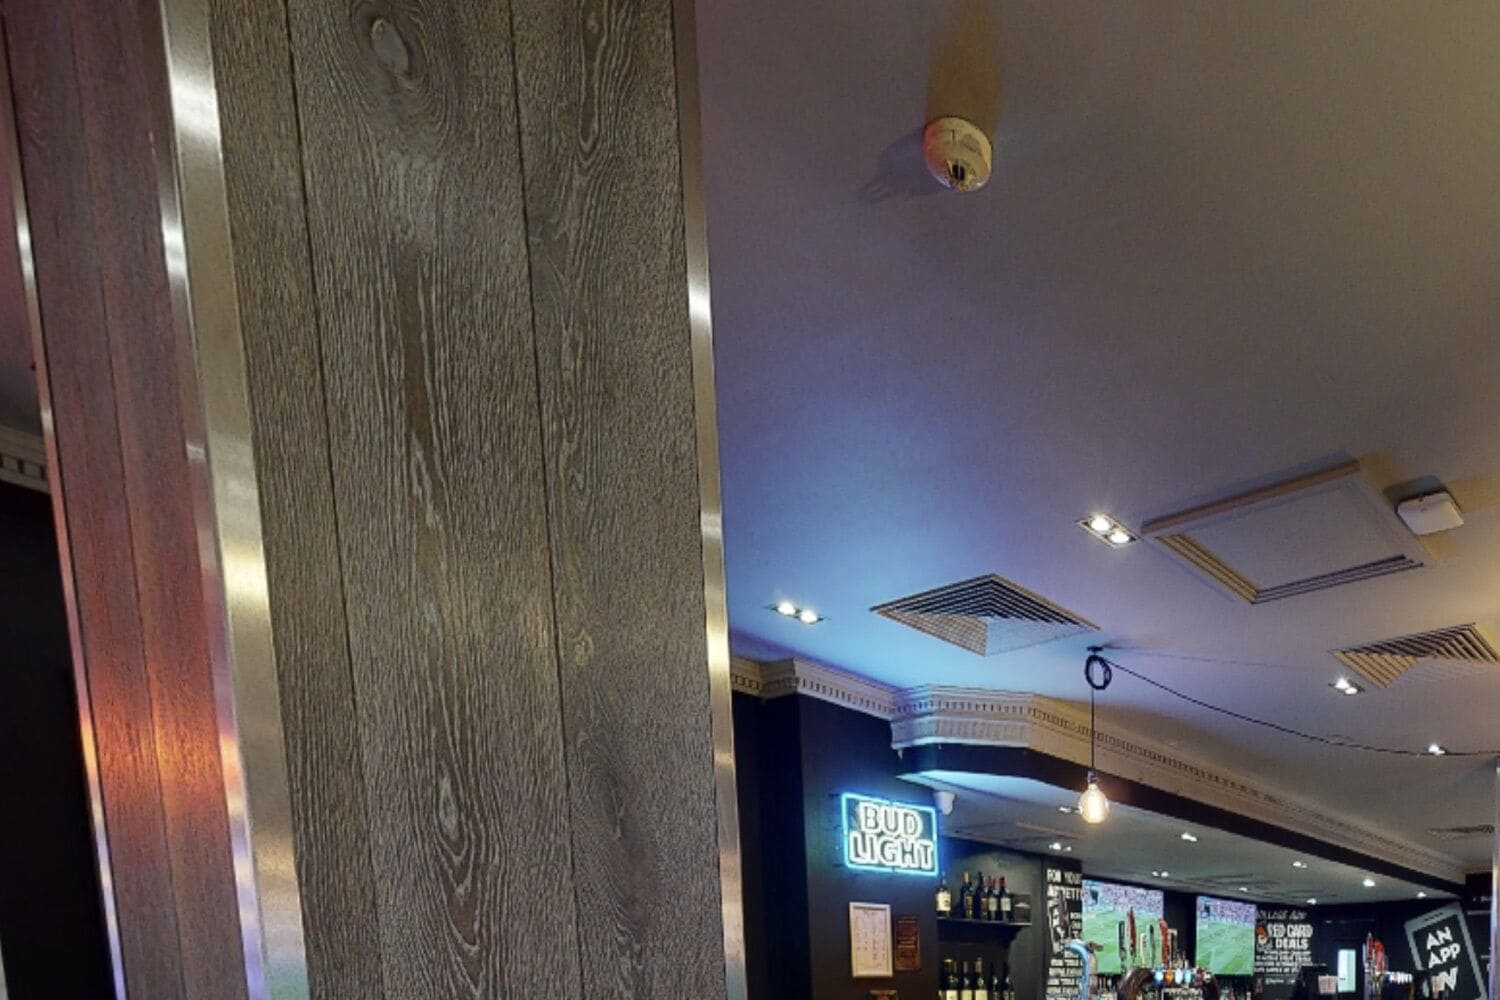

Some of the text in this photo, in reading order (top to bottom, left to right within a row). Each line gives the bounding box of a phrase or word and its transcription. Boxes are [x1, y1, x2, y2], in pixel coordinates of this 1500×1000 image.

[858, 803, 922, 837] BUD
[851, 832, 933, 869] LIGHT
[1047, 868, 1062, 883] FOR
[1287, 923, 1313, 938] CARD
[1426, 926, 1453, 950] AN
[1275, 938, 1308, 950] DEALS
[1428, 943, 1461, 969] APP
